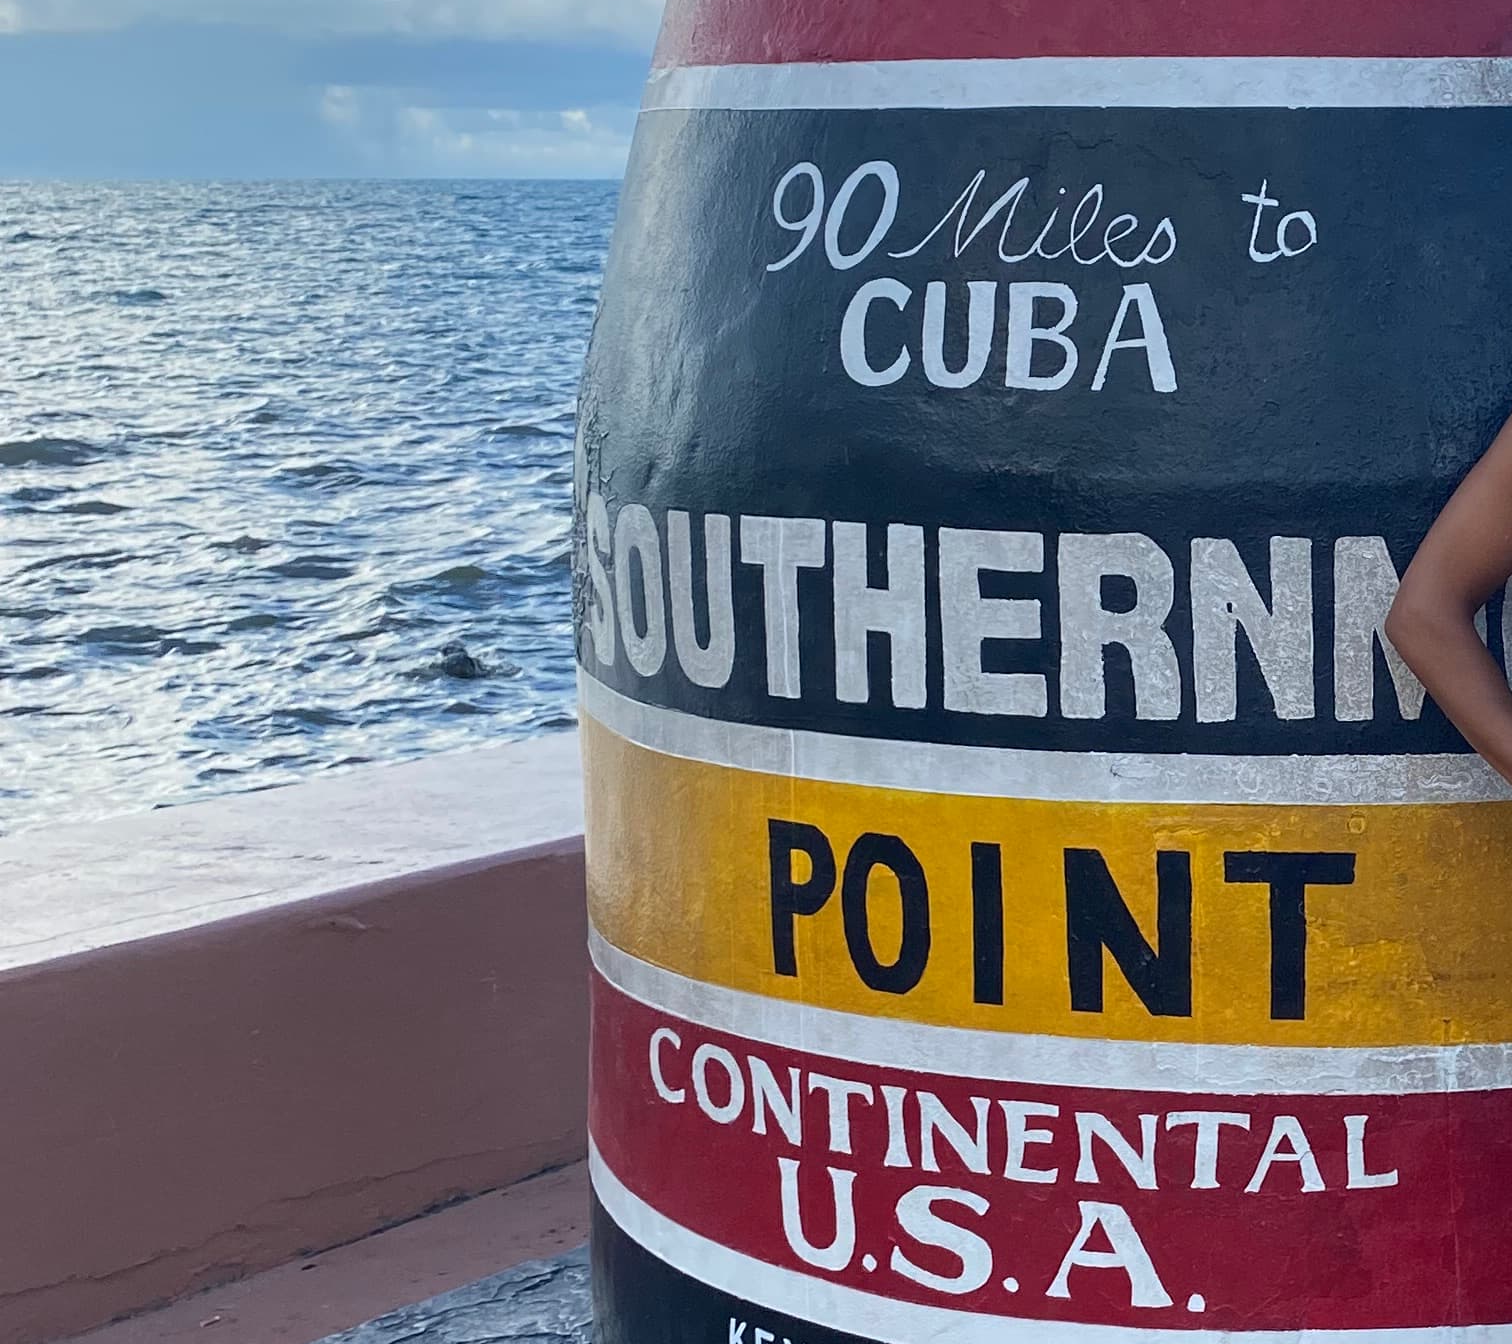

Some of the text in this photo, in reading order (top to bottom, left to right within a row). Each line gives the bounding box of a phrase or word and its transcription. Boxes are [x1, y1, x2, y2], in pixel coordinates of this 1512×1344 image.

[766, 159, 1318, 271] 90 Miles to
[840, 278, 1178, 393] CUBA
[767, 818, 1356, 1021] POINT
[648, 1027, 1399, 1194] CONTINENTAL
[778, 1157, 1207, 1312] U.S.A.
